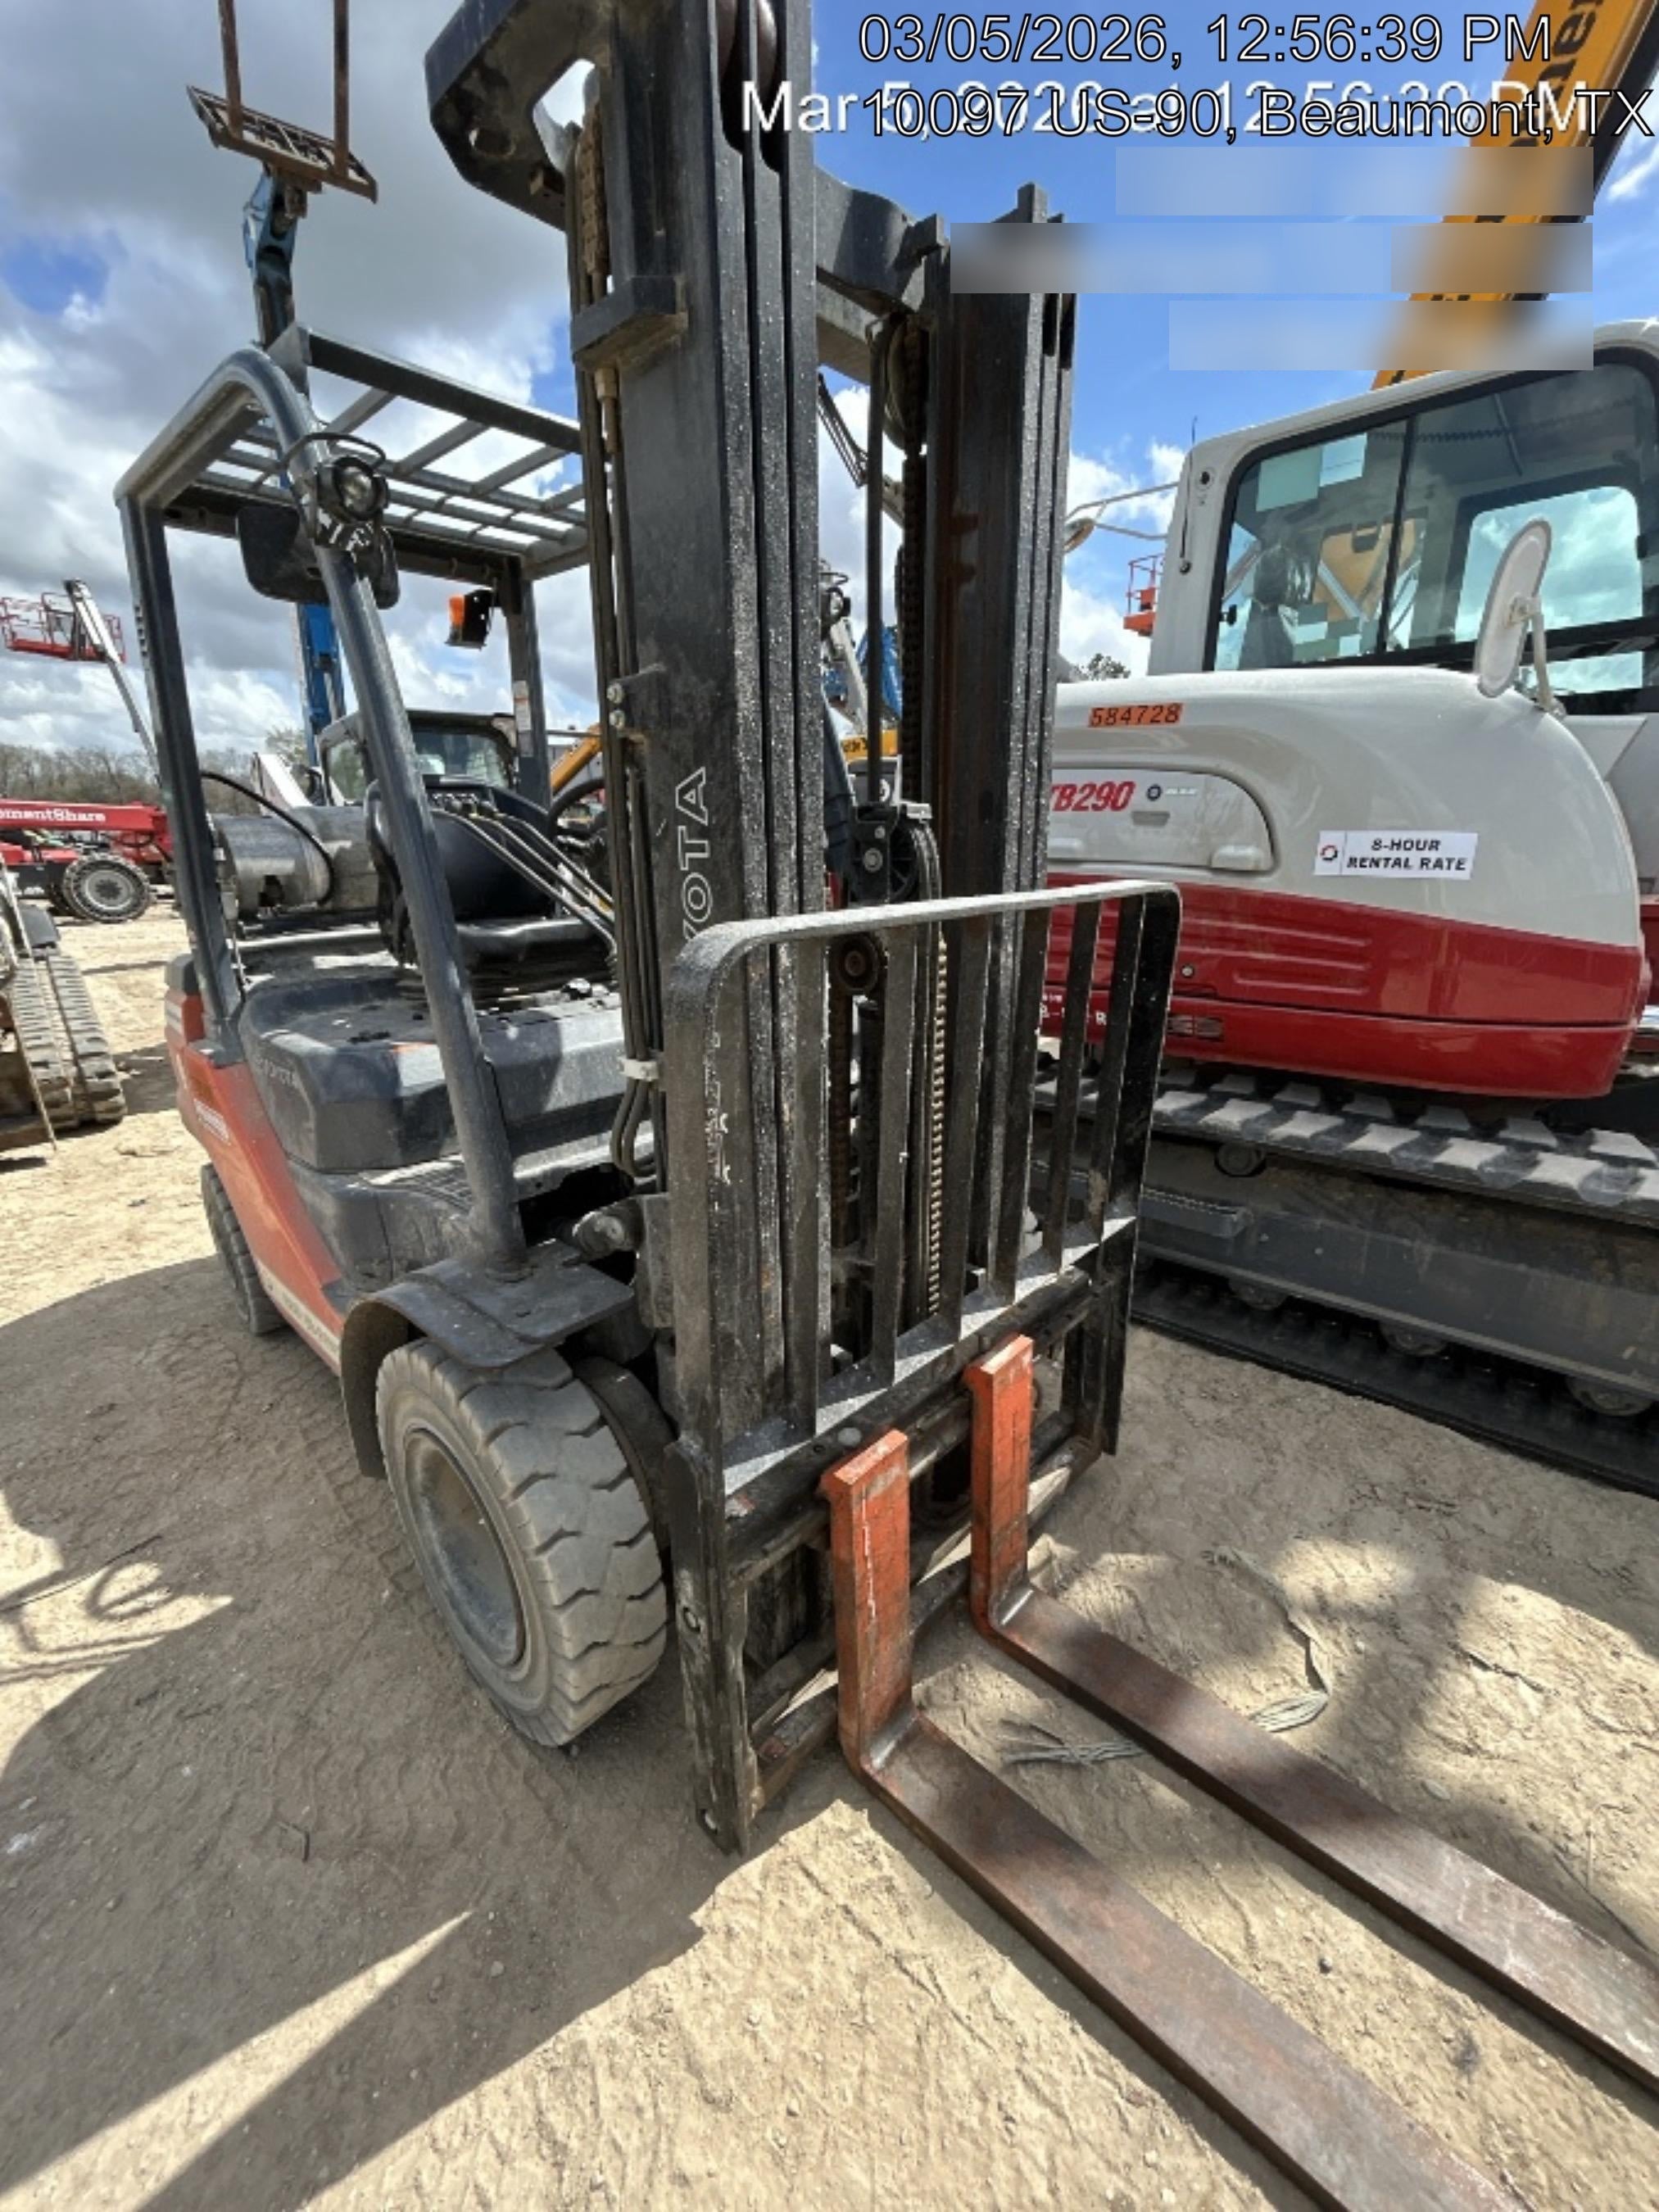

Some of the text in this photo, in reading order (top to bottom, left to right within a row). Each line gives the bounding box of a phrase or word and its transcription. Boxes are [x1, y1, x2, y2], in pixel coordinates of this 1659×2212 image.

[1090, 703, 1181, 728] 584728
[1371, 838, 1441, 852] 8-HOUR
[1346, 857, 1468, 871] RENTAL RATE
